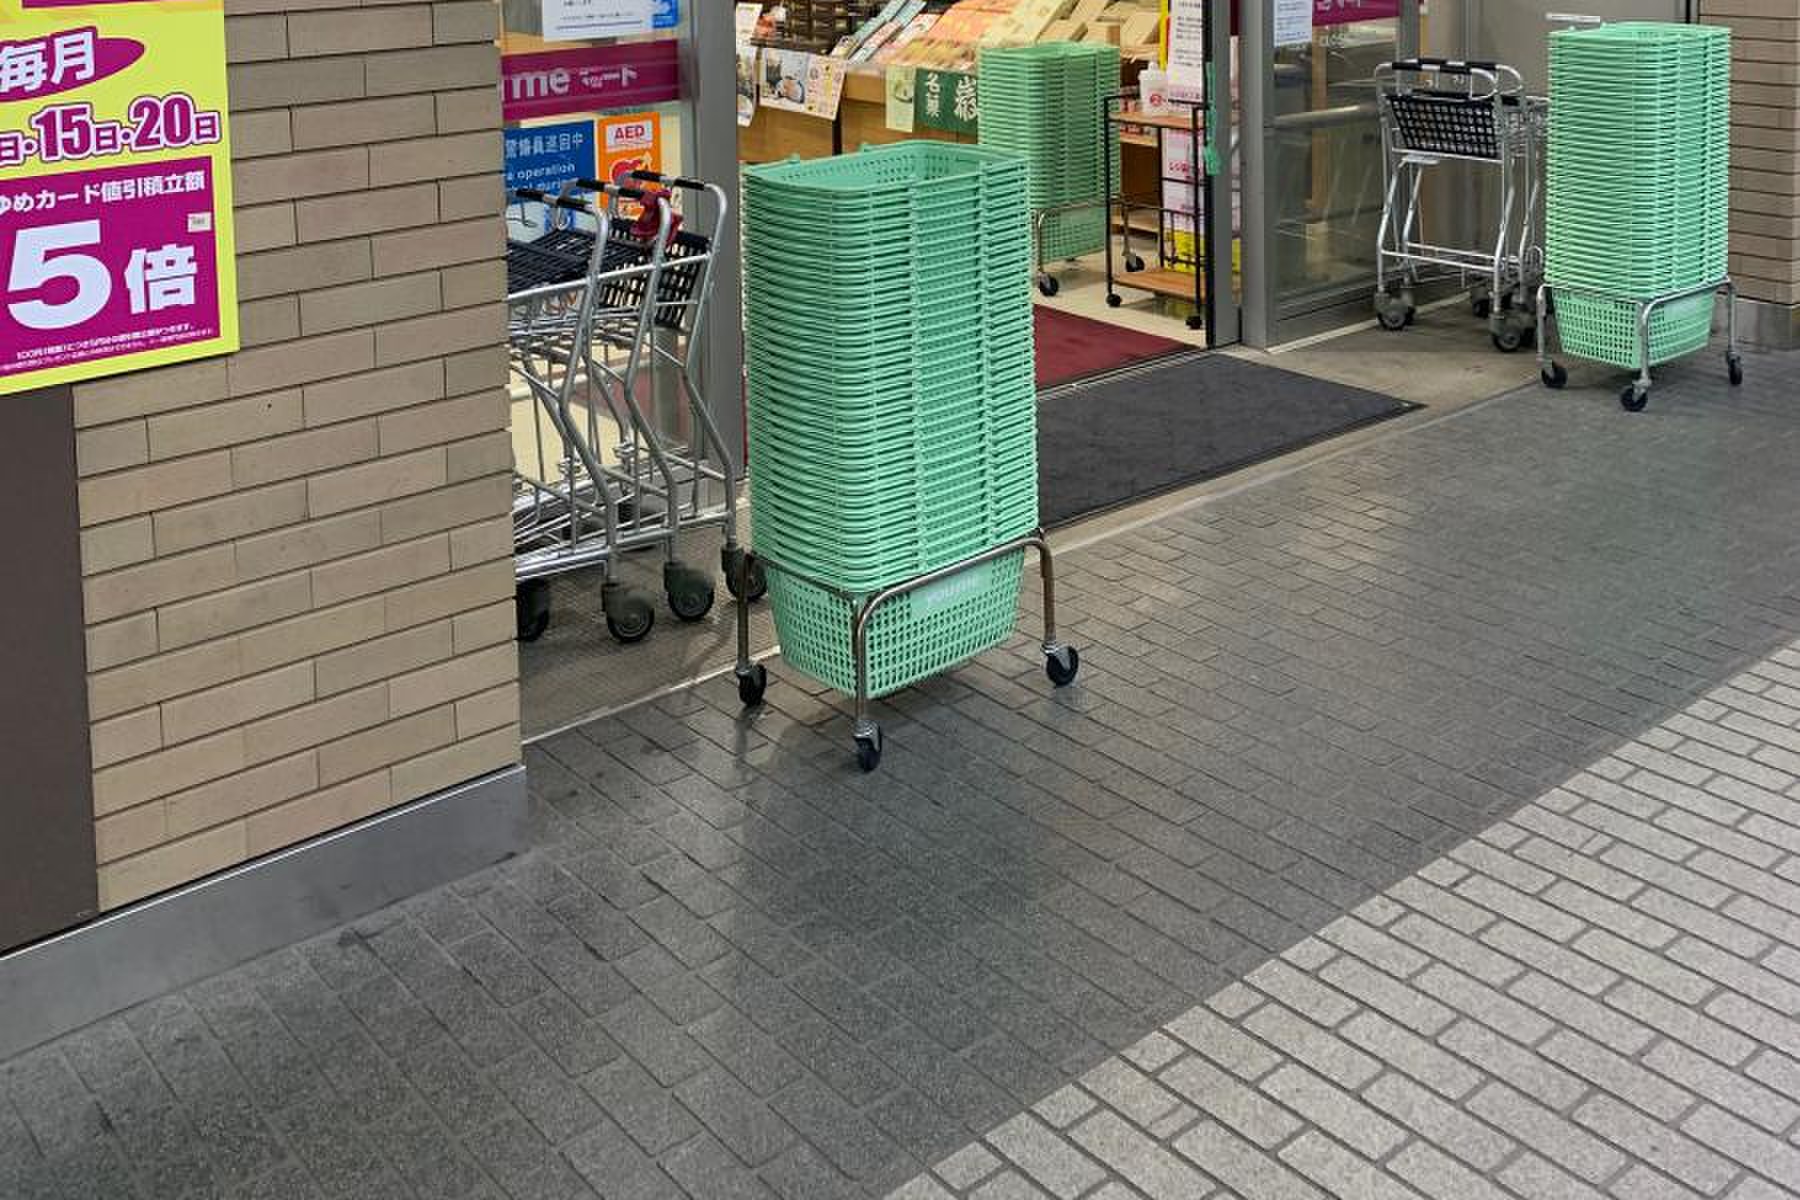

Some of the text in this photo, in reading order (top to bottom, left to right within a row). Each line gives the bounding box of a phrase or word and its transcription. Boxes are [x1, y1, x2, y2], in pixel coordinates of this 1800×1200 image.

[0, 30, 96, 93] 毎月
[511, 68, 571, 99] me
[613, 125, 646, 140] AED
